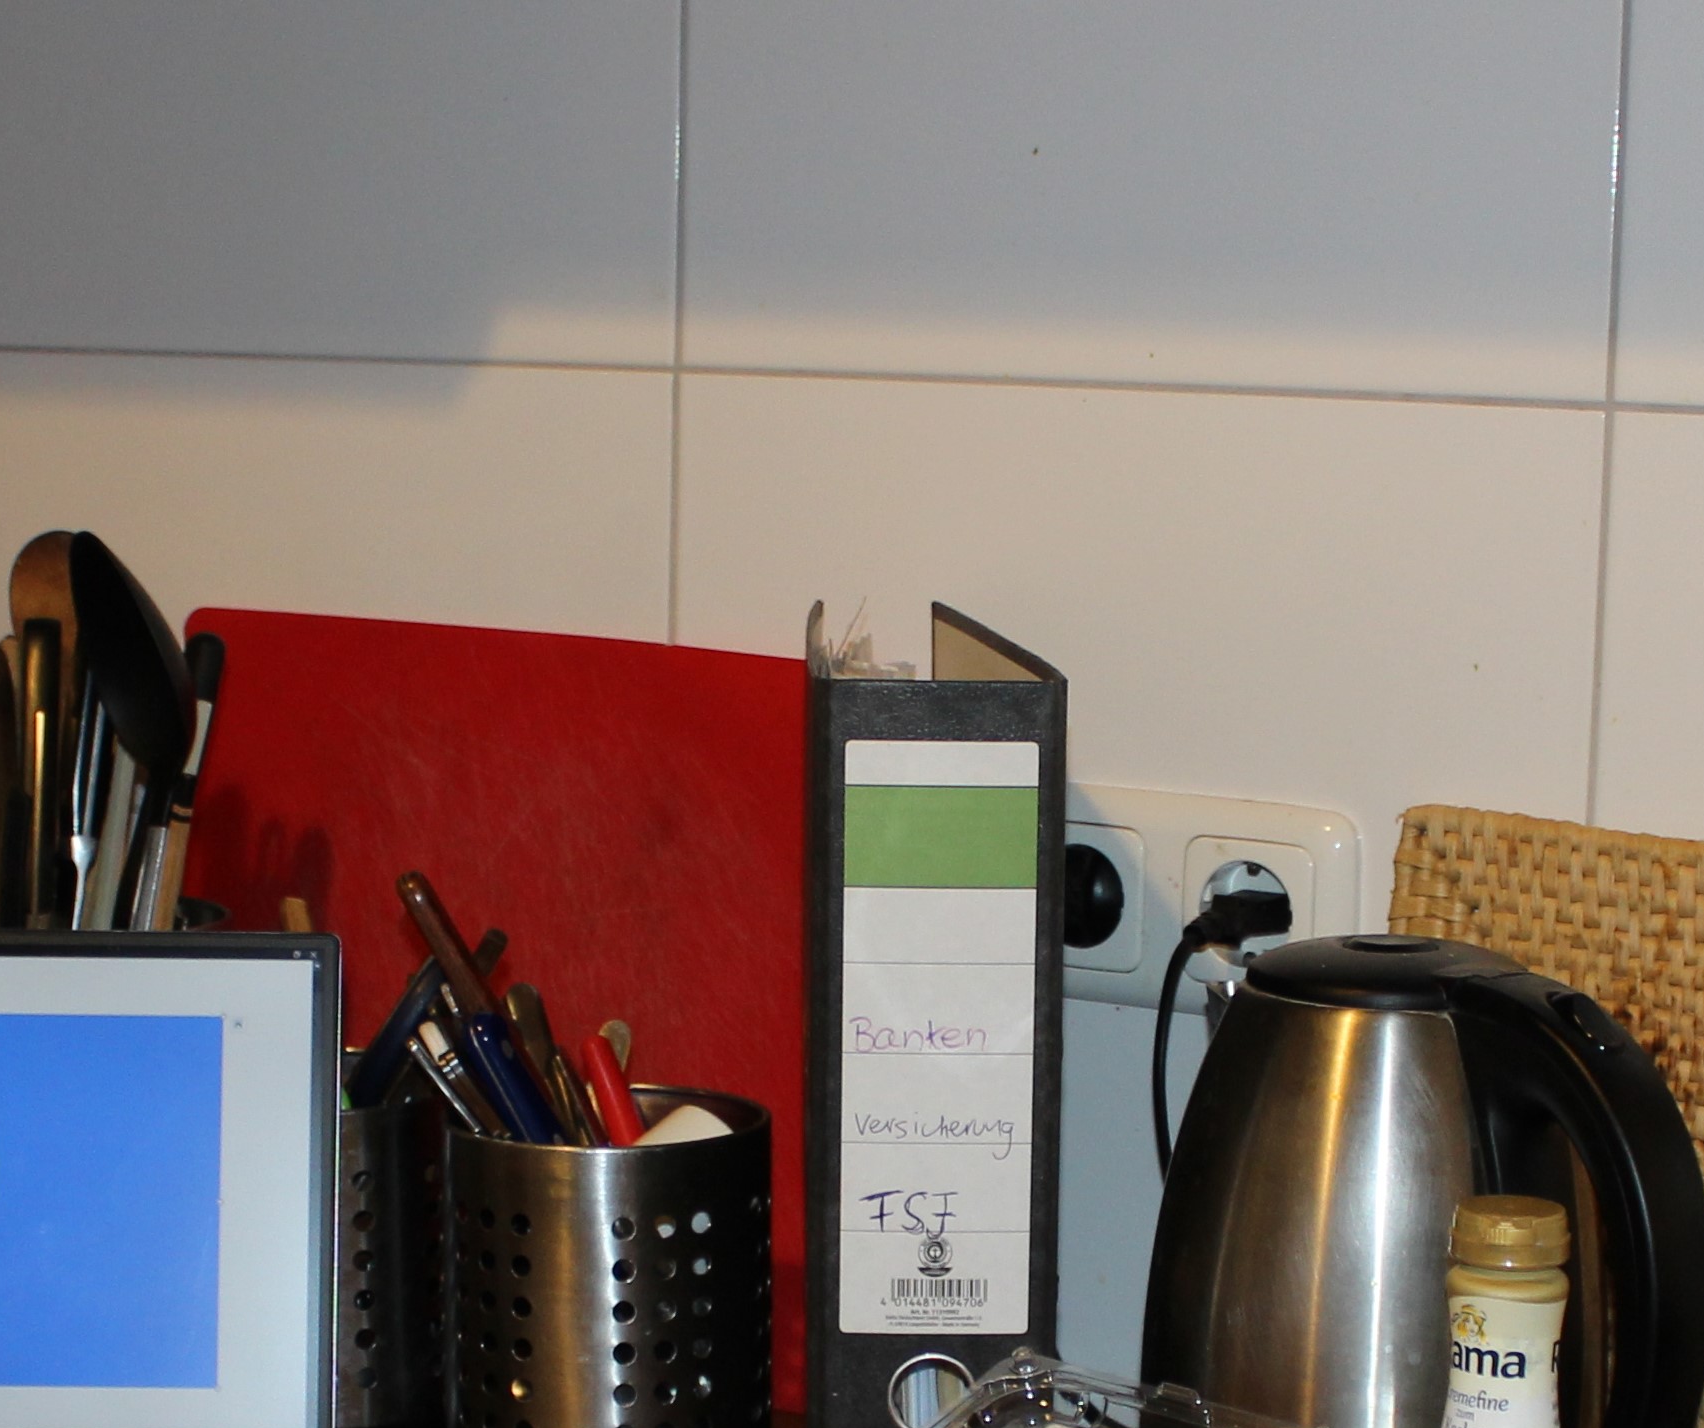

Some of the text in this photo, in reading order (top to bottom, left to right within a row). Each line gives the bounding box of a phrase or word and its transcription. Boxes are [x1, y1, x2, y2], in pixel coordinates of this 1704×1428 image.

[849, 1016, 987, 1053] Banken
[855, 1111, 1015, 1161] Versicherung
[1452, 1341, 1527, 1379] ama
